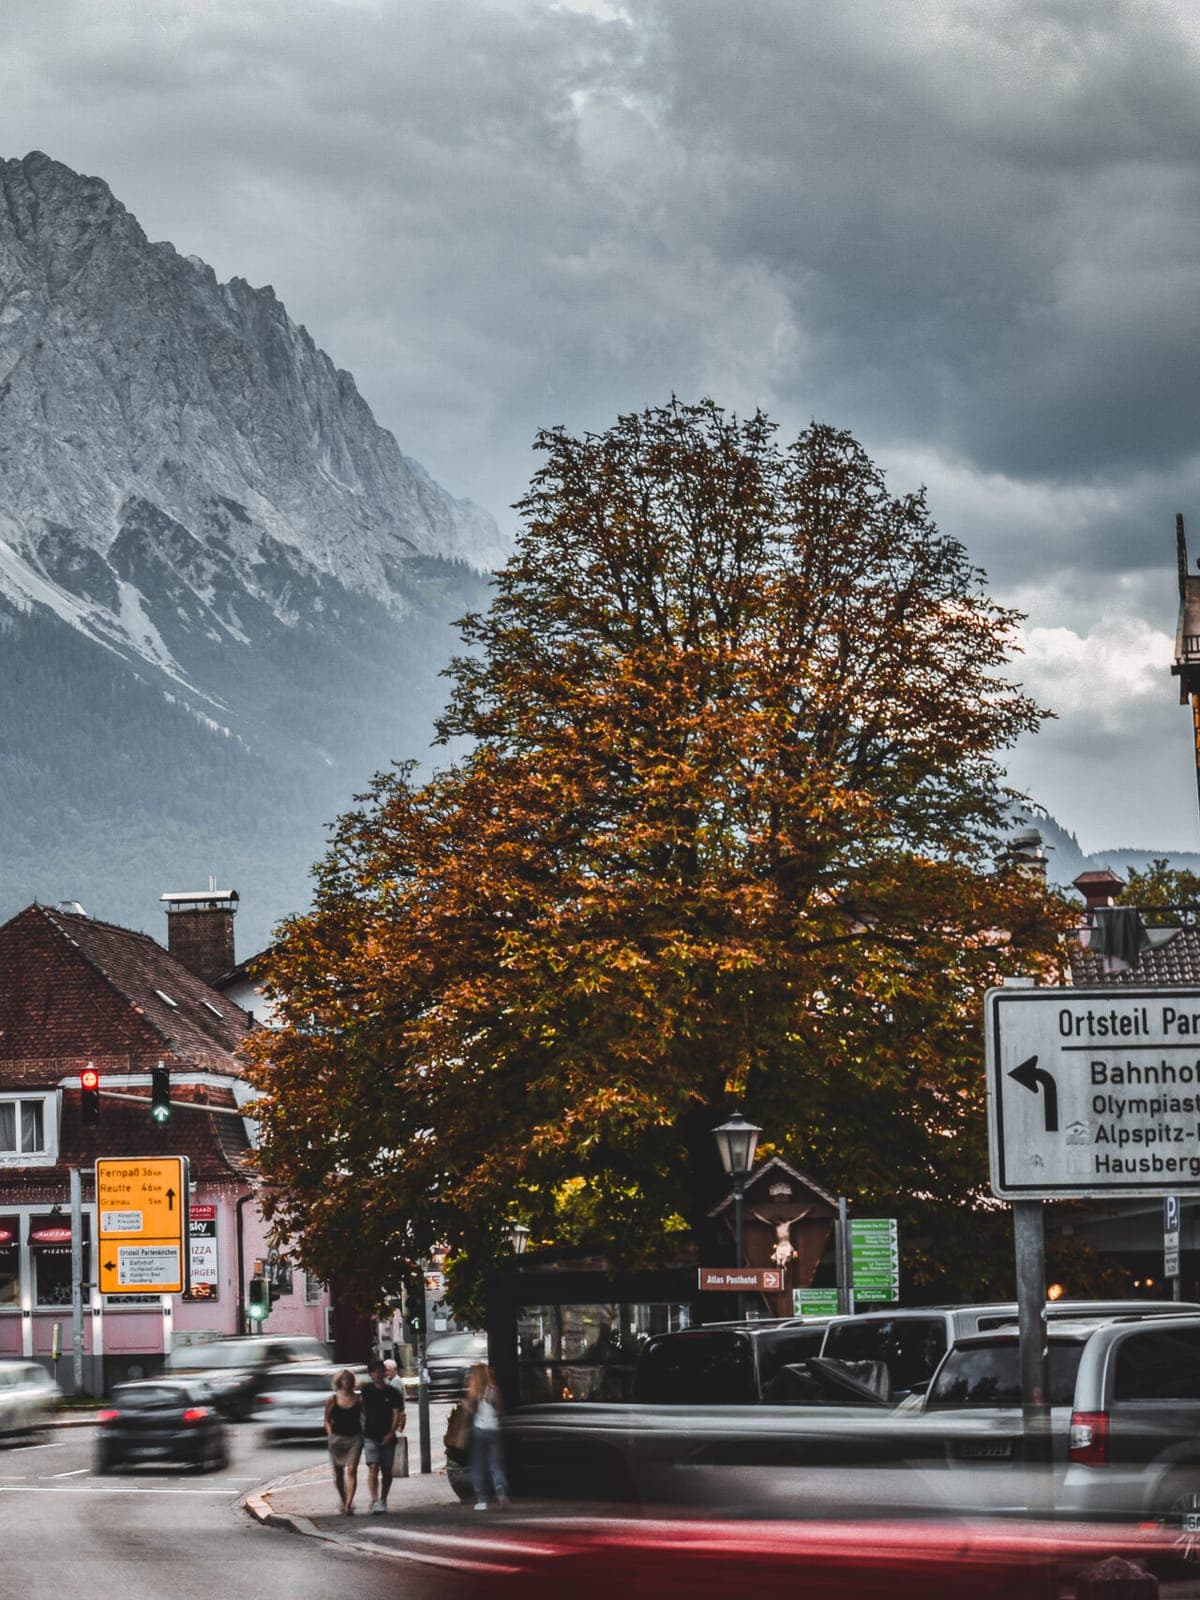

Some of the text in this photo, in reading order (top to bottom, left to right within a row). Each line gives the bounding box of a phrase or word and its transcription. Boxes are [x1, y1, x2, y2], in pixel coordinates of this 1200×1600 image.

[1058, 1006, 1200, 1037] Ortsteil Par
[1095, 1153, 1200, 1176] Hausberg
[100, 1168, 139, 1178] Fernpaß
[100, 1184, 131, 1192] Reutte
[141, 1183, 153, 1192] 46
[190, 1220, 207, 1232] sky
[192, 1246, 212, 1255] IZZA
[707, 1275, 757, 1284] Atlas Posthotel
